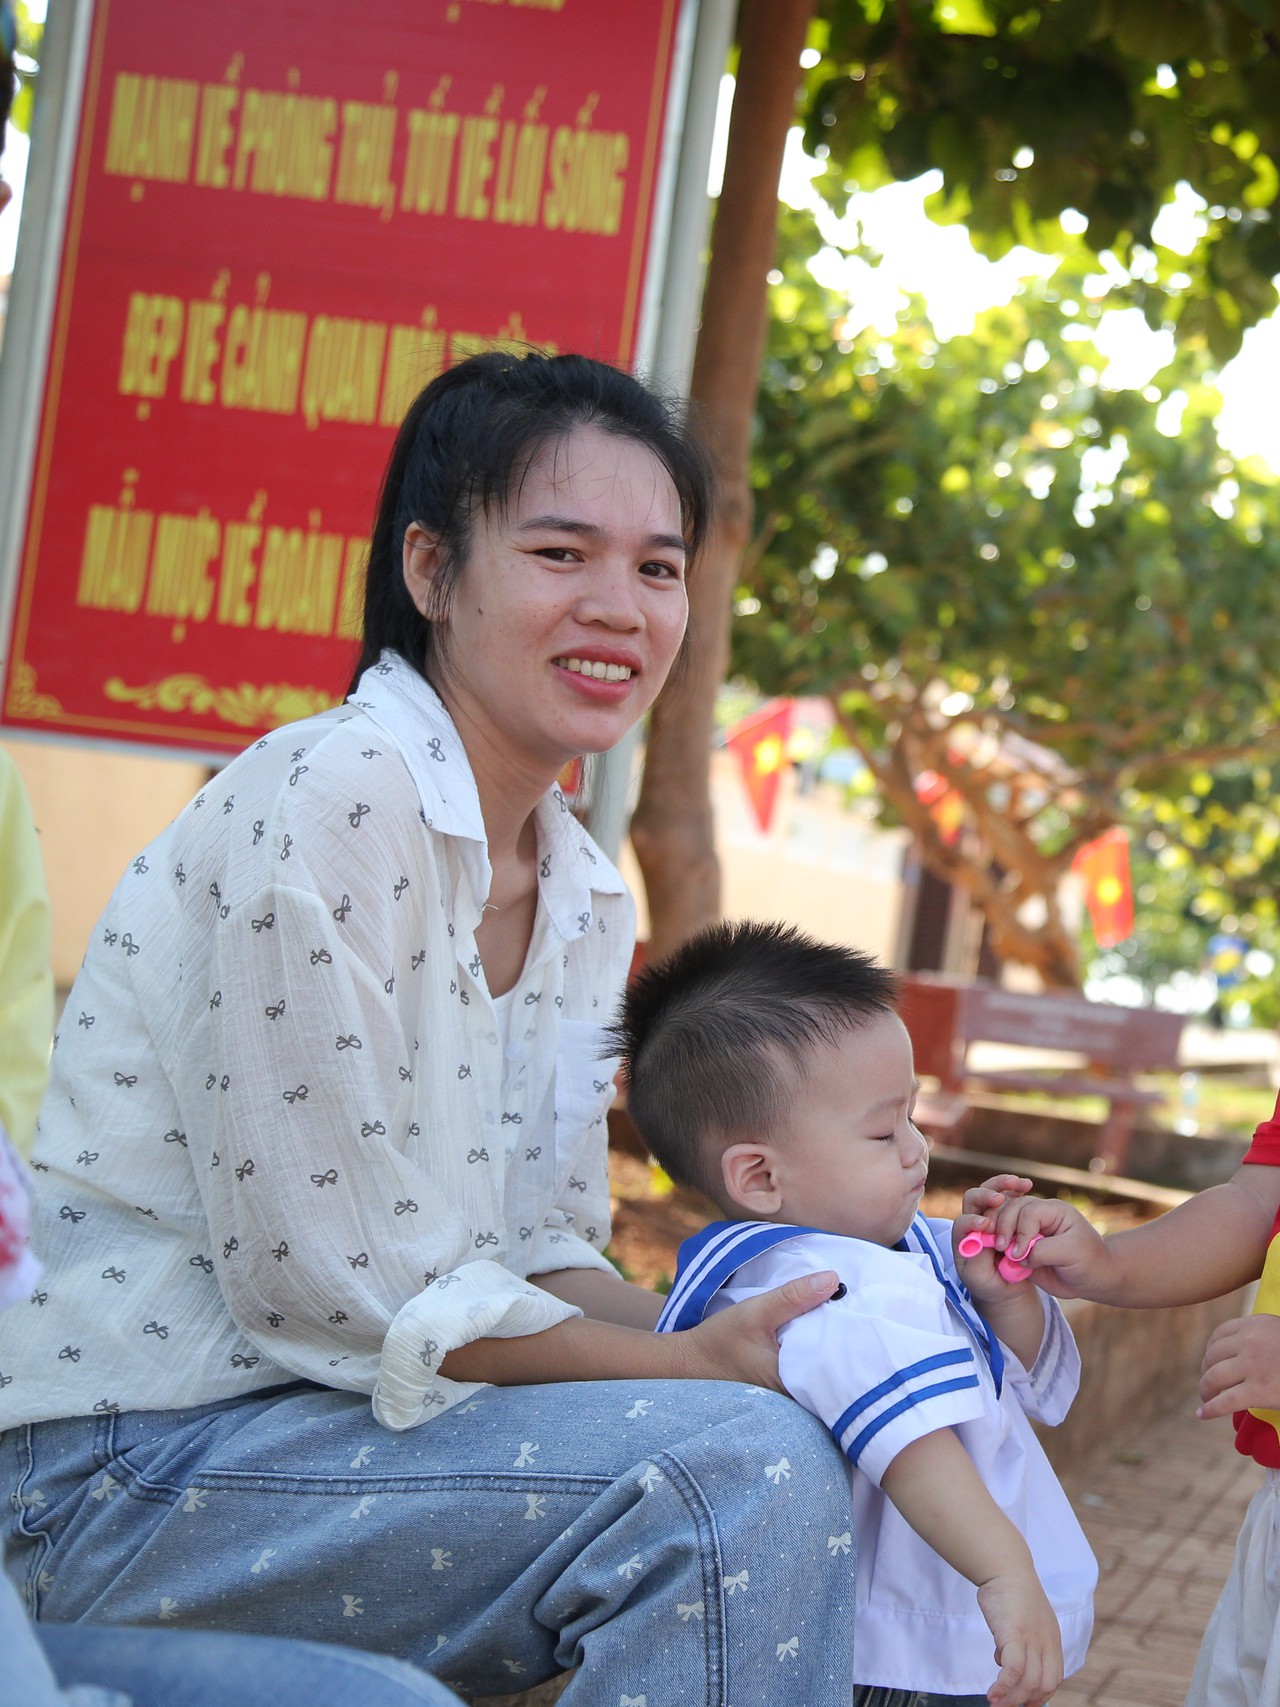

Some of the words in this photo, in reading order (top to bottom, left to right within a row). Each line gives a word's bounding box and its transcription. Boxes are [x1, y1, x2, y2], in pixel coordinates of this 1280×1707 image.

[104, 70, 199, 201] MẠNH
[232, 67, 338, 202] PHÒNG
[401, 74, 458, 215] TỐT
[493, 85, 548, 227] LỐI
[543, 92, 629, 236] SỐNG
[222, 271, 307, 415] CẢNH
[303, 313, 387, 431] QUAN
